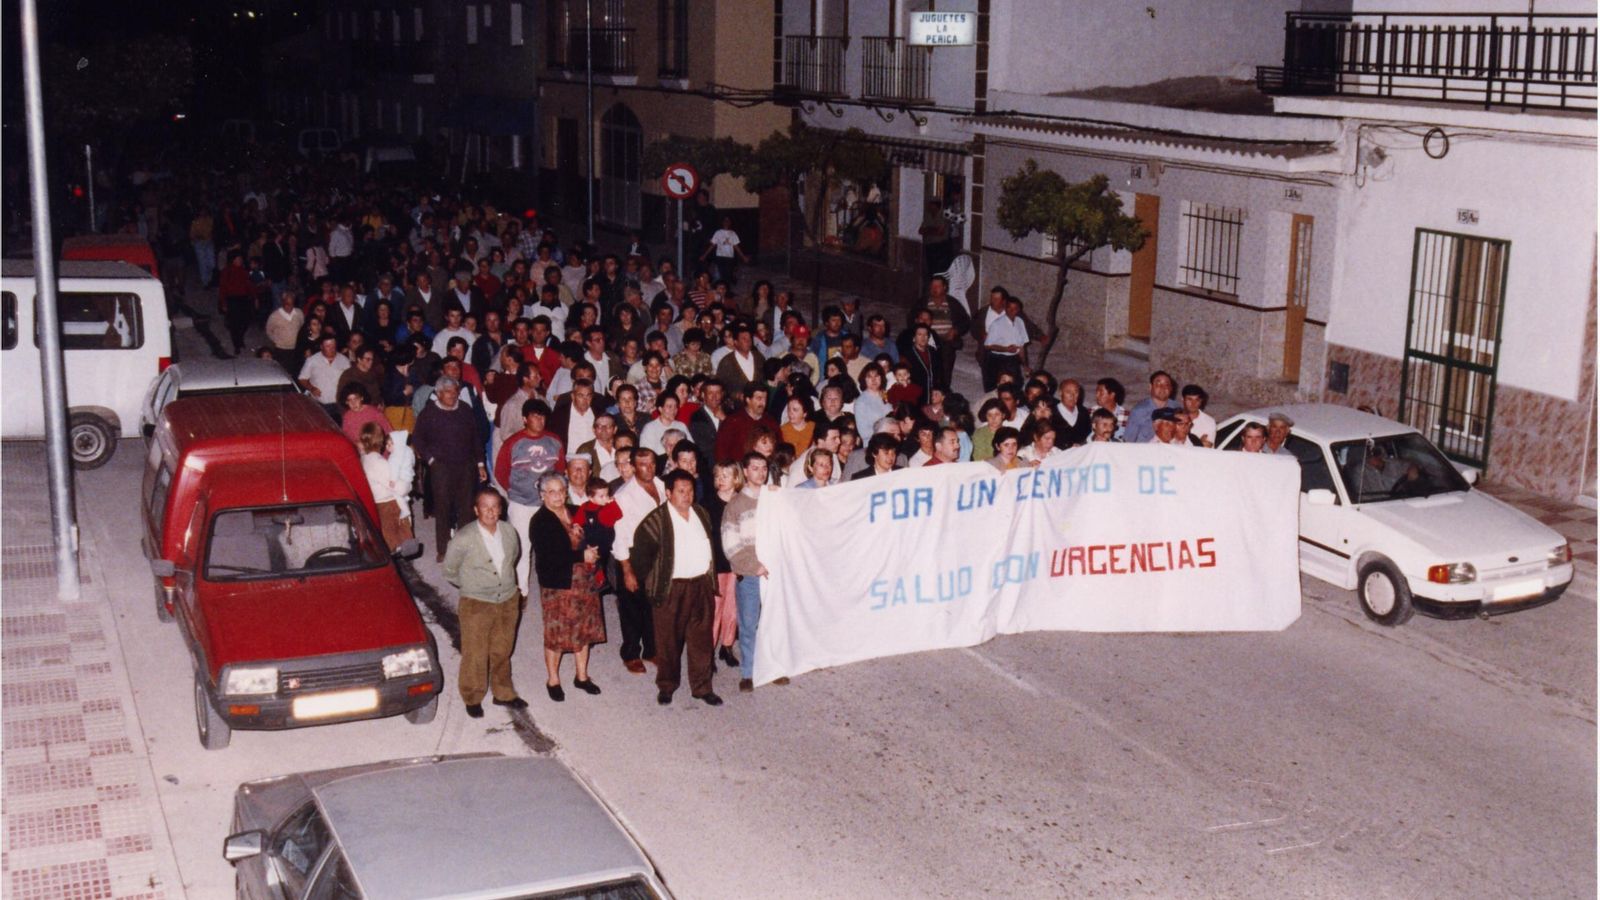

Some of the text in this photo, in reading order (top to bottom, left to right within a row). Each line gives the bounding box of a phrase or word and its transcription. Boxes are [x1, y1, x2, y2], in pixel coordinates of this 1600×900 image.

[919, 13, 966, 23] JUGUETES
[936, 24, 948, 33] LA
[926, 34, 958, 44] PERICA
[869, 463, 1177, 523] POR UN CENTRO DE
[869, 537, 1217, 611] SALUD CON URGENCIAS
